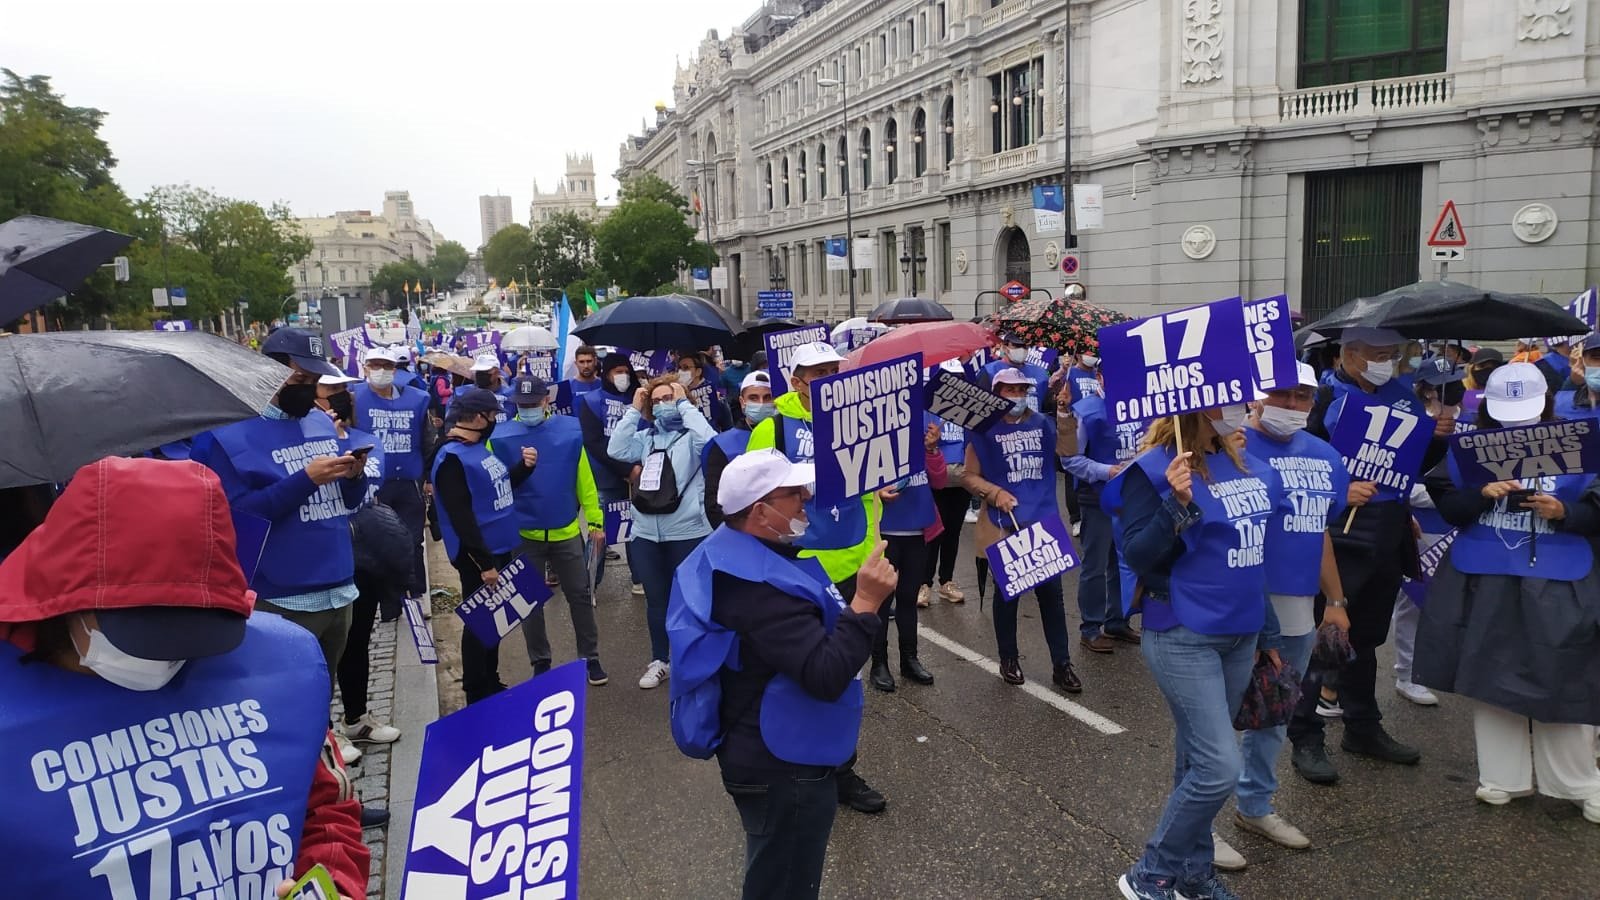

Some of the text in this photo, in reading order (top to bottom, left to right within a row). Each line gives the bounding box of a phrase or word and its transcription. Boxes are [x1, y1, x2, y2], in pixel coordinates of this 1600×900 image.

[1574, 289, 1591, 319] 17
[474, 332, 492, 348] 17
[770, 326, 826, 350] COMISIONES
[1126, 306, 1210, 367] 17
[968, 348, 986, 372] 17
[820, 359, 918, 412] COMISIONES
[940, 372, 1010, 410] COMISIONES
[1147, 362, 1204, 395] AÑOS
[928, 394, 984, 430] YA!
[934, 383, 996, 418] JUSTAS
[1116, 379, 1242, 422] CONGELADAS
[372, 416, 410, 428] JUSTAS
[832, 388, 912, 450] JUSTAS
[1364, 405, 1418, 449] 17
[1002, 438, 1042, 454] JUSTAS
[1458, 421, 1590, 449] COMISIONES
[1474, 436, 1582, 464] JUSTAS
[272, 439, 338, 464] COMISIONES
[835, 426, 910, 498] YA!
[1006, 453, 1022, 472] 17
[1269, 457, 1333, 472] COMISIONES
[1356, 442, 1396, 468] AÑOS
[1480, 451, 1584, 480] YA!
[1208, 477, 1268, 498] COMISIONES
[1280, 470, 1332, 491] JUSTAS
[1221, 489, 1271, 518] JUSTAS
[1287, 490, 1308, 516] 17
[997, 522, 1055, 566] YA!
[1234, 518, 1253, 548] 17
[1004, 540, 1062, 582] JUSTAS
[1005, 554, 1074, 597] COMISIONES
[484, 580, 516, 610] AÑOS
[493, 593, 538, 638] 17
[30, 699, 269, 792] COMISIONES
[68, 738, 269, 848] JUSTAS
[90, 828, 172, 900] 17
[178, 813, 294, 896] AÑOS
